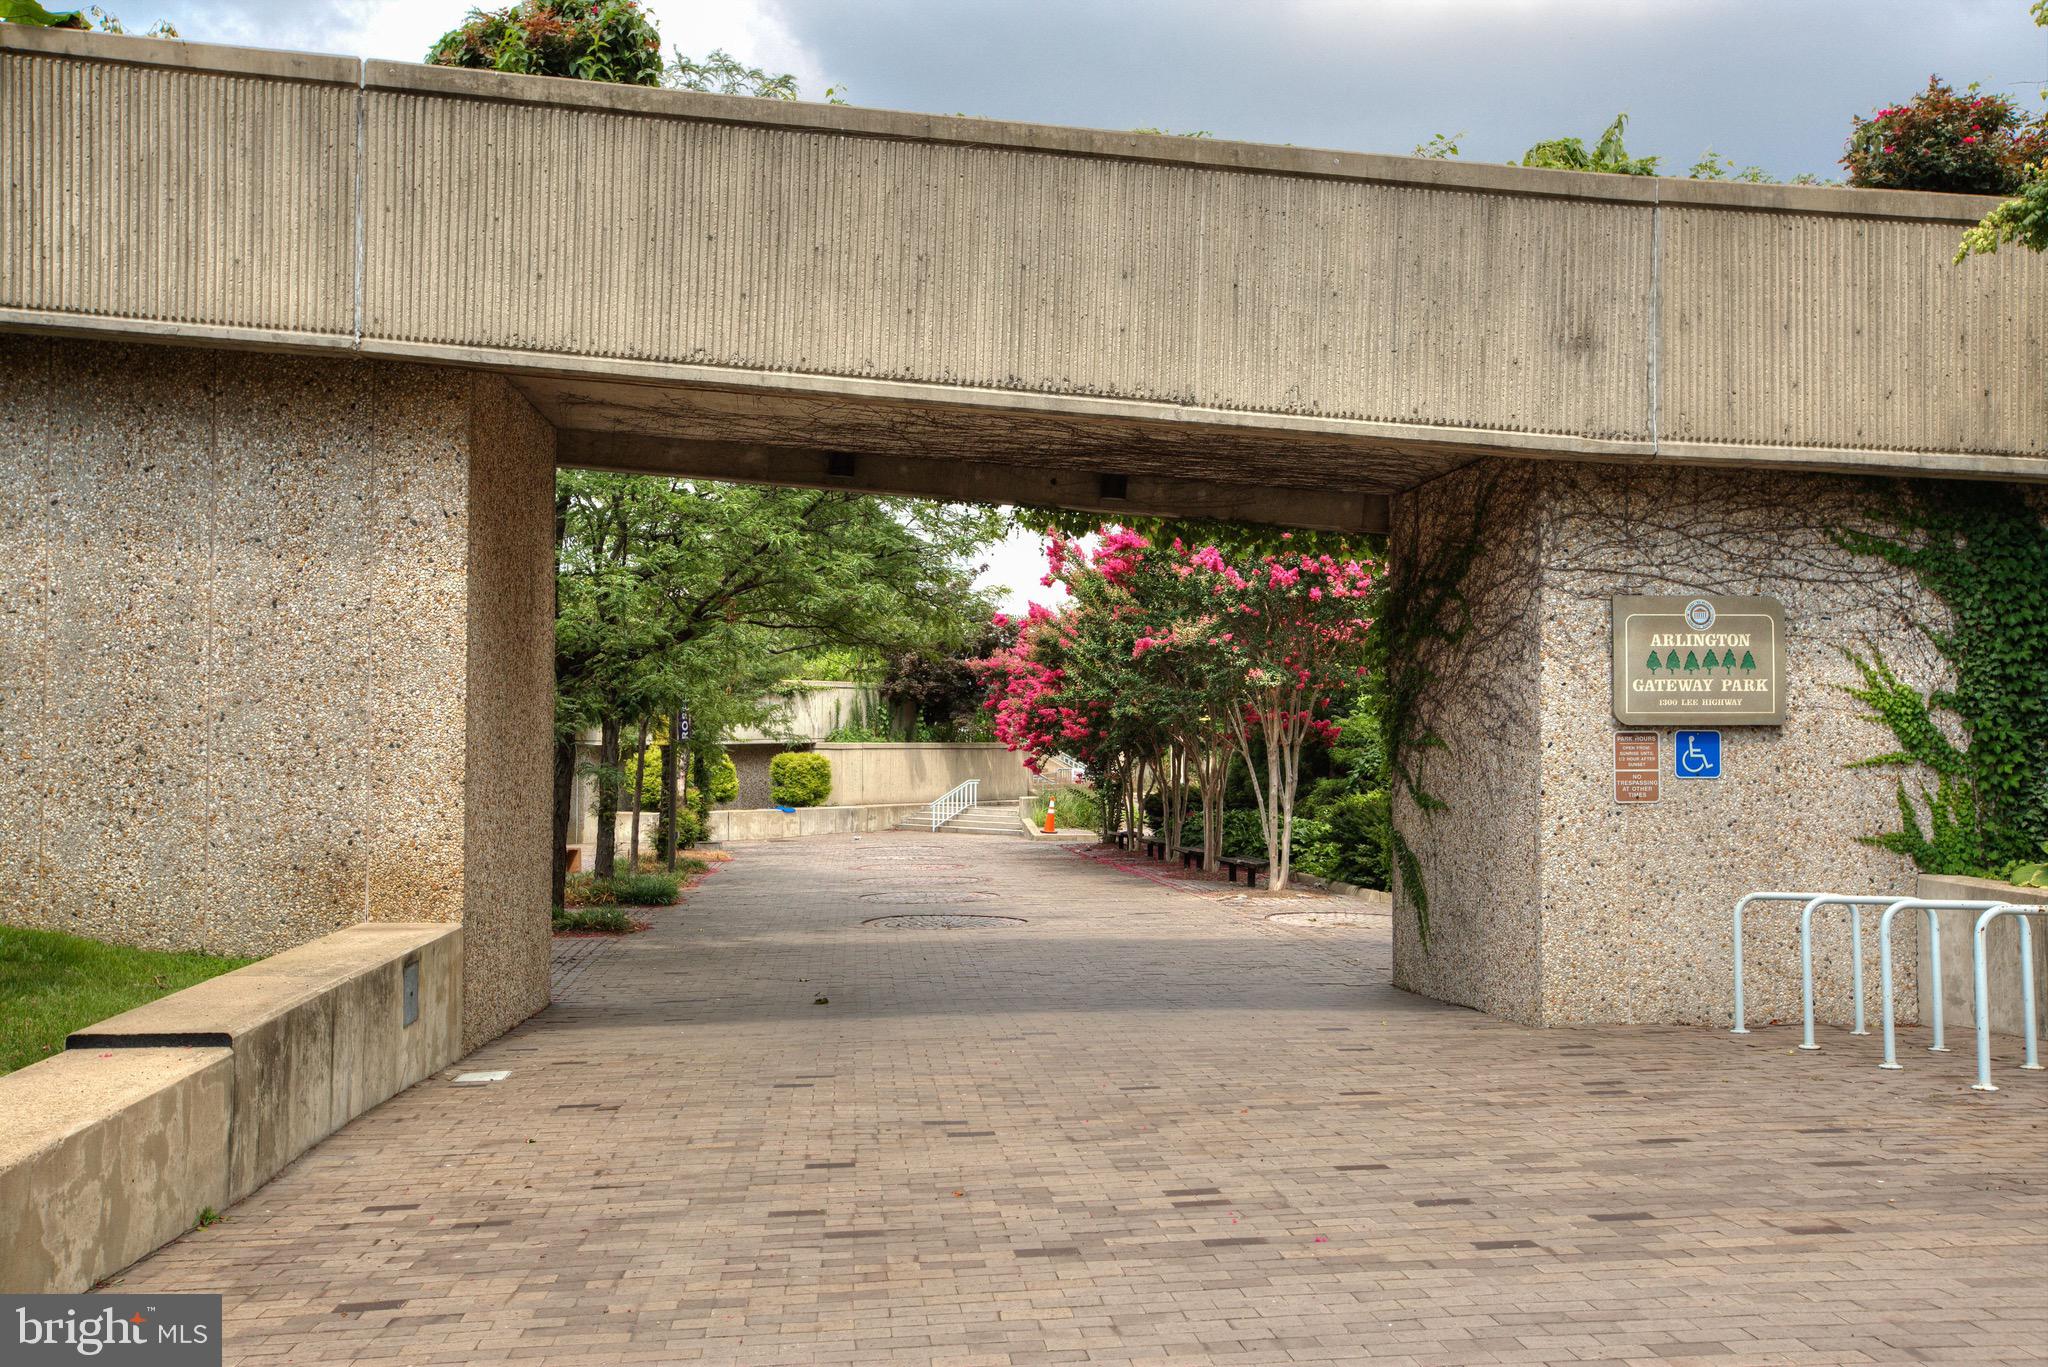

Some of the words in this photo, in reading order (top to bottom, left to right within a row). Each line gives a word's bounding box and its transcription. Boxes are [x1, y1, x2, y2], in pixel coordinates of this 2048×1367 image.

[1650, 633, 1751, 647] ARLINGTON
[1632, 678, 1714, 692] GATEWAY
[1721, 678, 1769, 692] PARK
